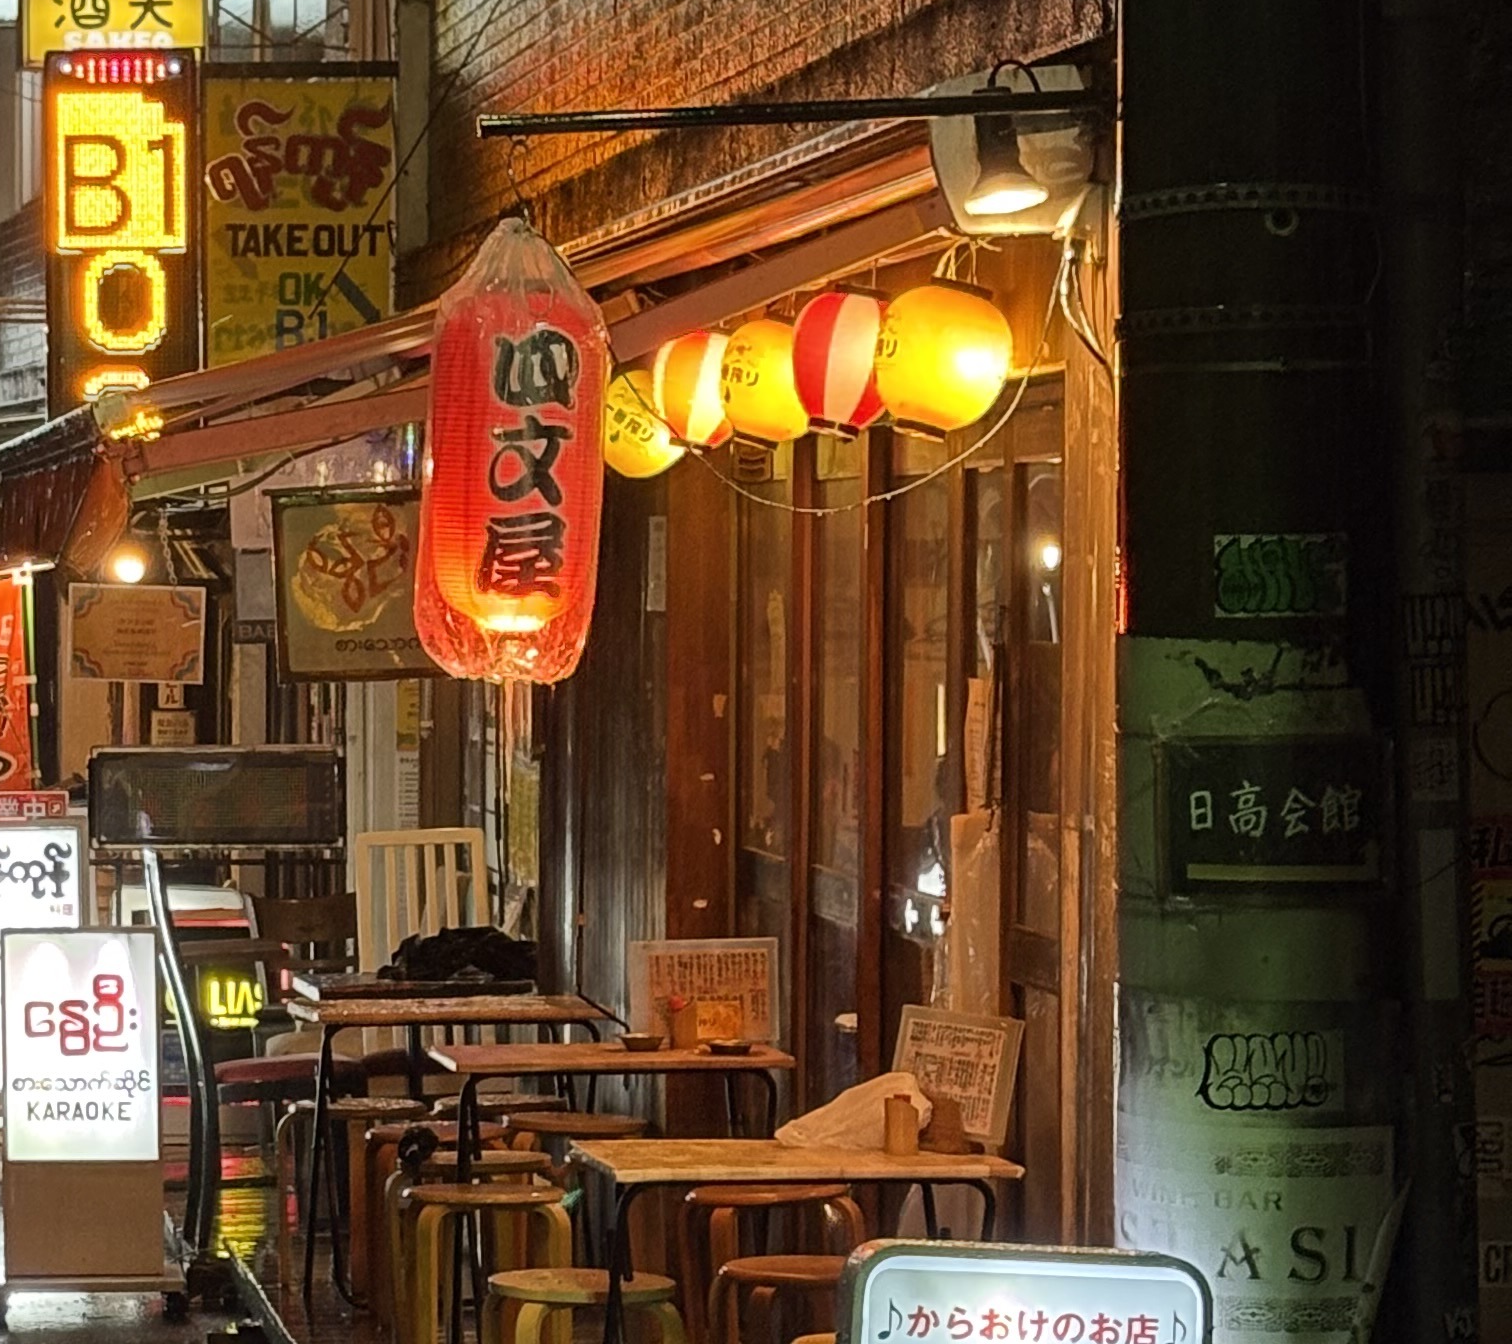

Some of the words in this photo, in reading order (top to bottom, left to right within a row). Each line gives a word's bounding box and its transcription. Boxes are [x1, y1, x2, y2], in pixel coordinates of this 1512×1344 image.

[63, 133, 175, 237] B1
[277, 271, 327, 307] OK
[474, 327, 581, 598] 四文屋
[1188, 779, 1364, 841] 日高会館
[26, 1101, 134, 1123] KARAOKE
